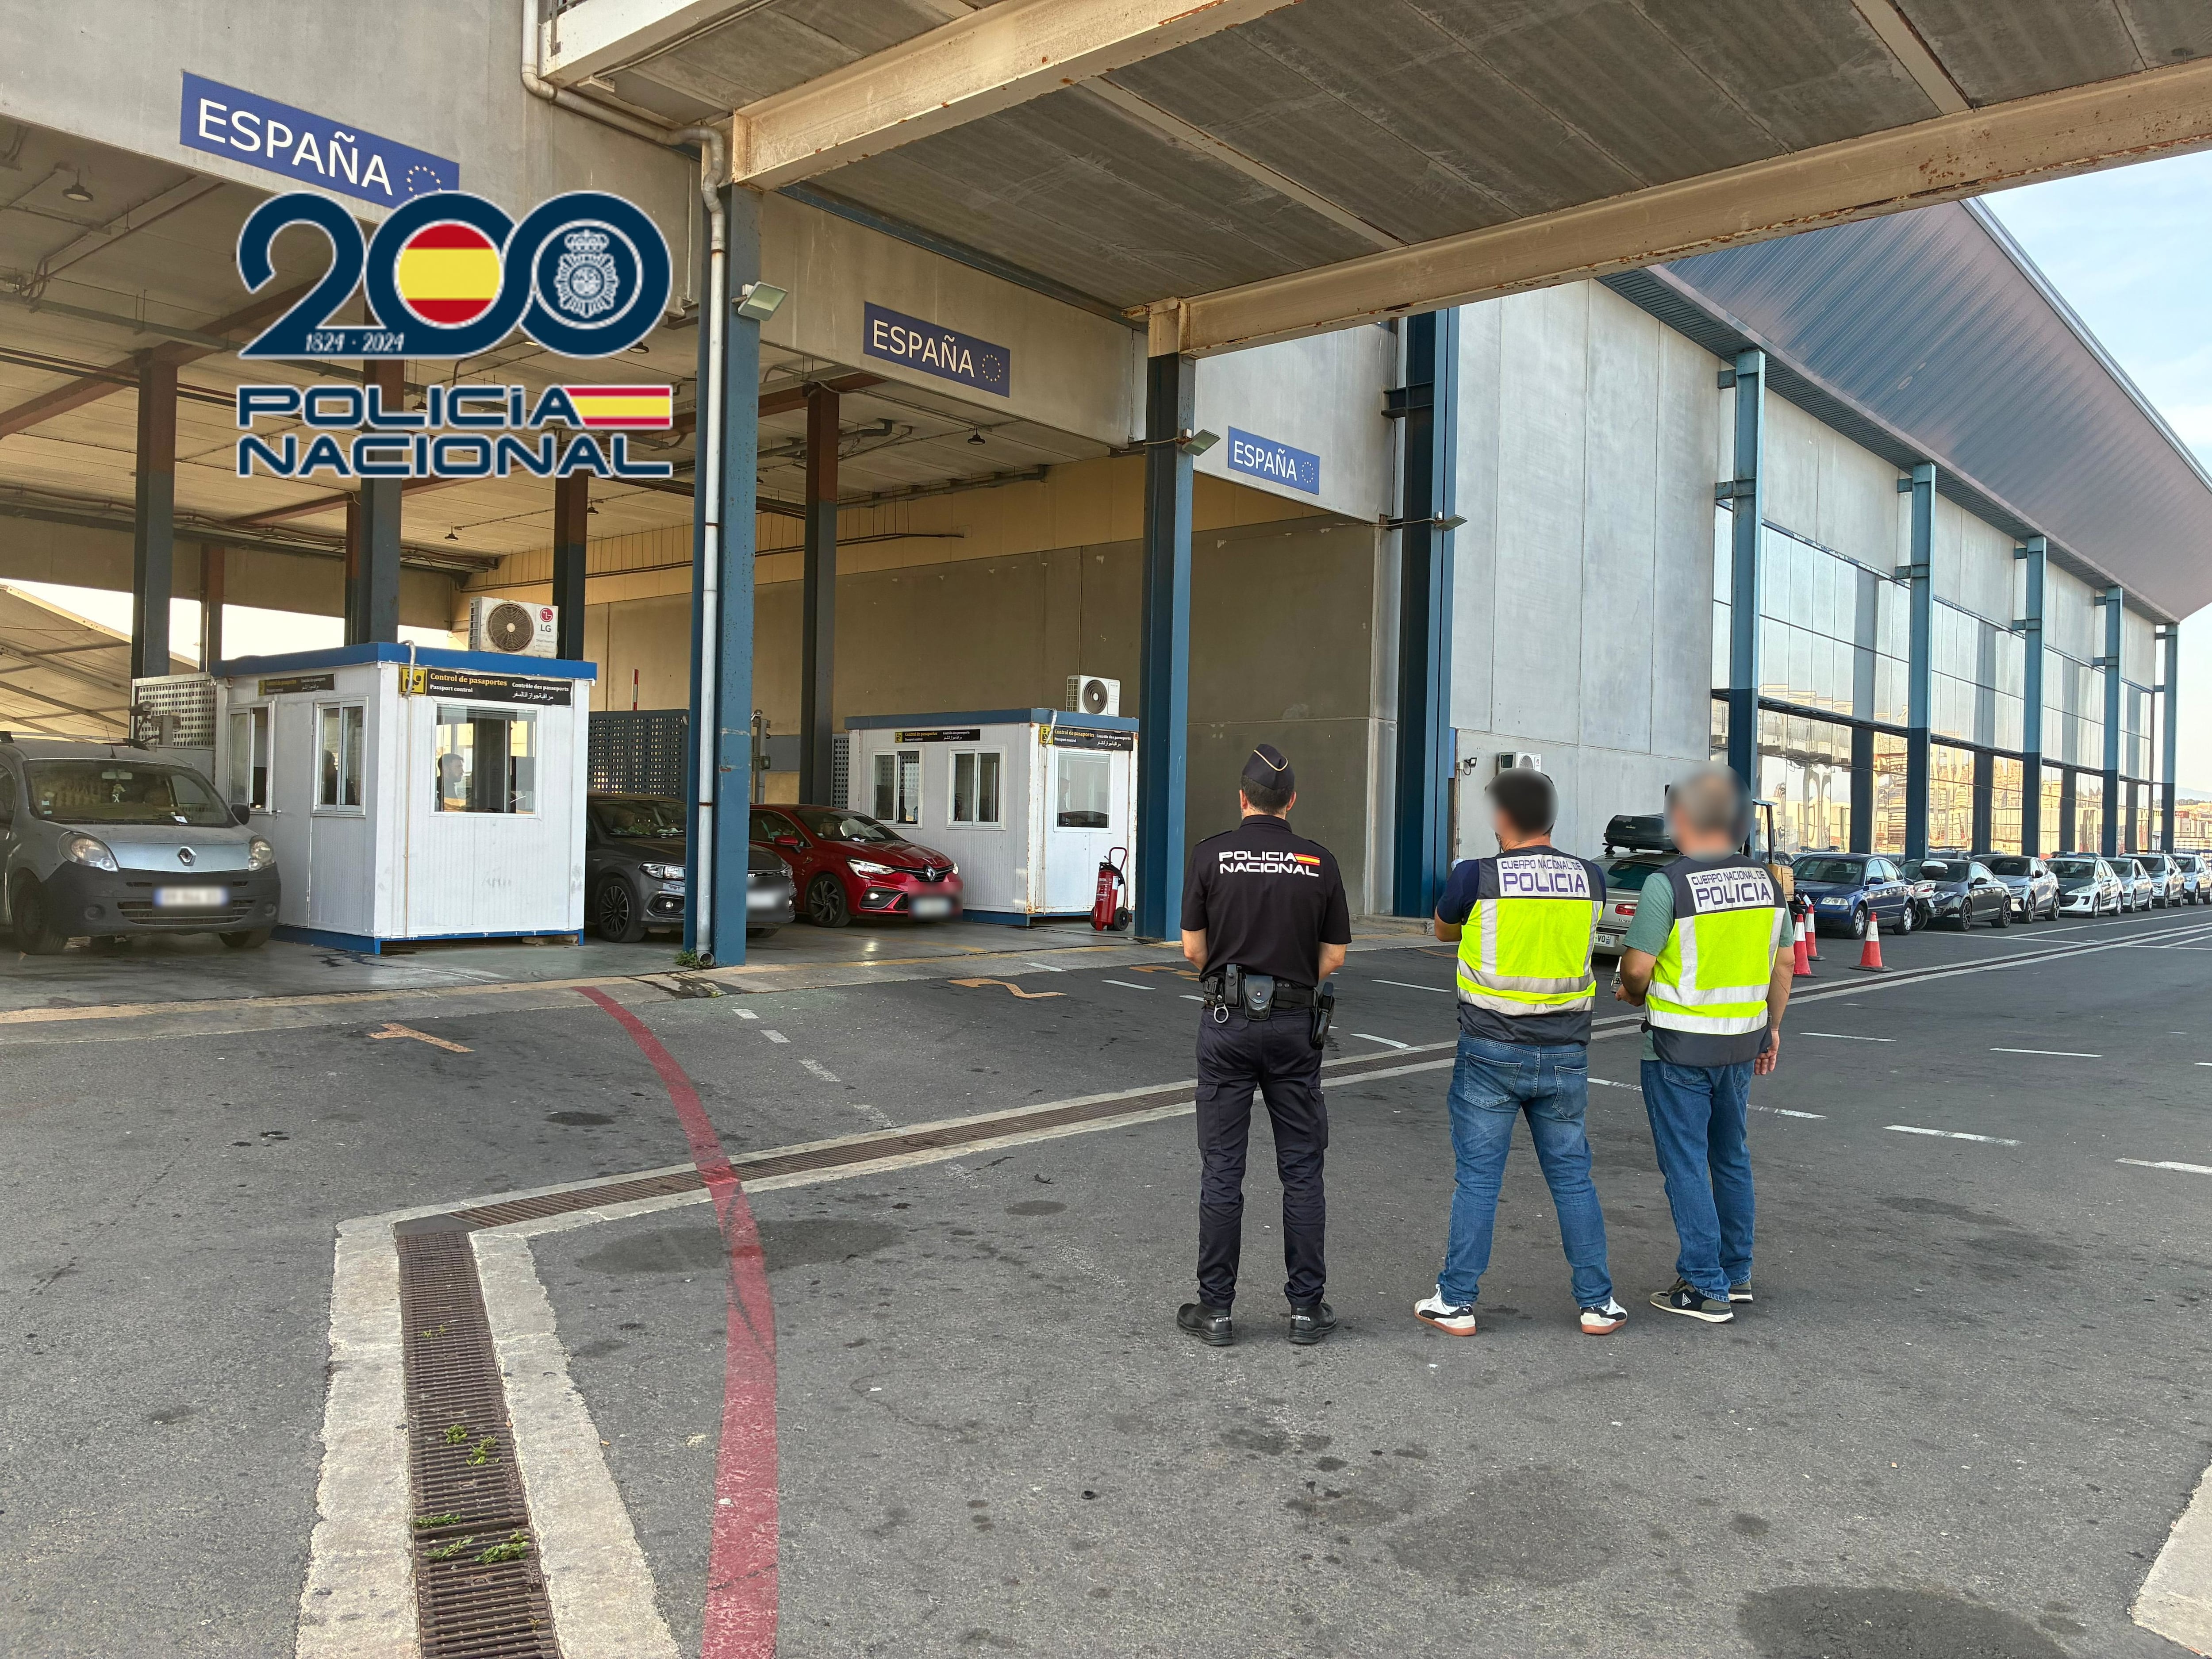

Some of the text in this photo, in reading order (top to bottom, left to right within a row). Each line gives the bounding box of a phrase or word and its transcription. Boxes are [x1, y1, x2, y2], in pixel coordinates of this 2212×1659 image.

[199, 98, 393, 196] ESPAÑA
[873, 319, 975, 377] ESPAÑA
[1234, 440, 1297, 481] ESPAÑA
[430, 673, 457, 682] Control
[1219, 851, 1297, 862] POLICIA
[1220, 862, 1319, 877] NACIONAL
[1501, 860, 1536, 869] CUERPO
[1571, 862, 1582, 871] DE
[1503, 873, 1586, 893] POLICIA
[1691, 871, 1766, 885] CUERPO NACIONAL DE
[1695, 883, 1772, 907] POLICIA
